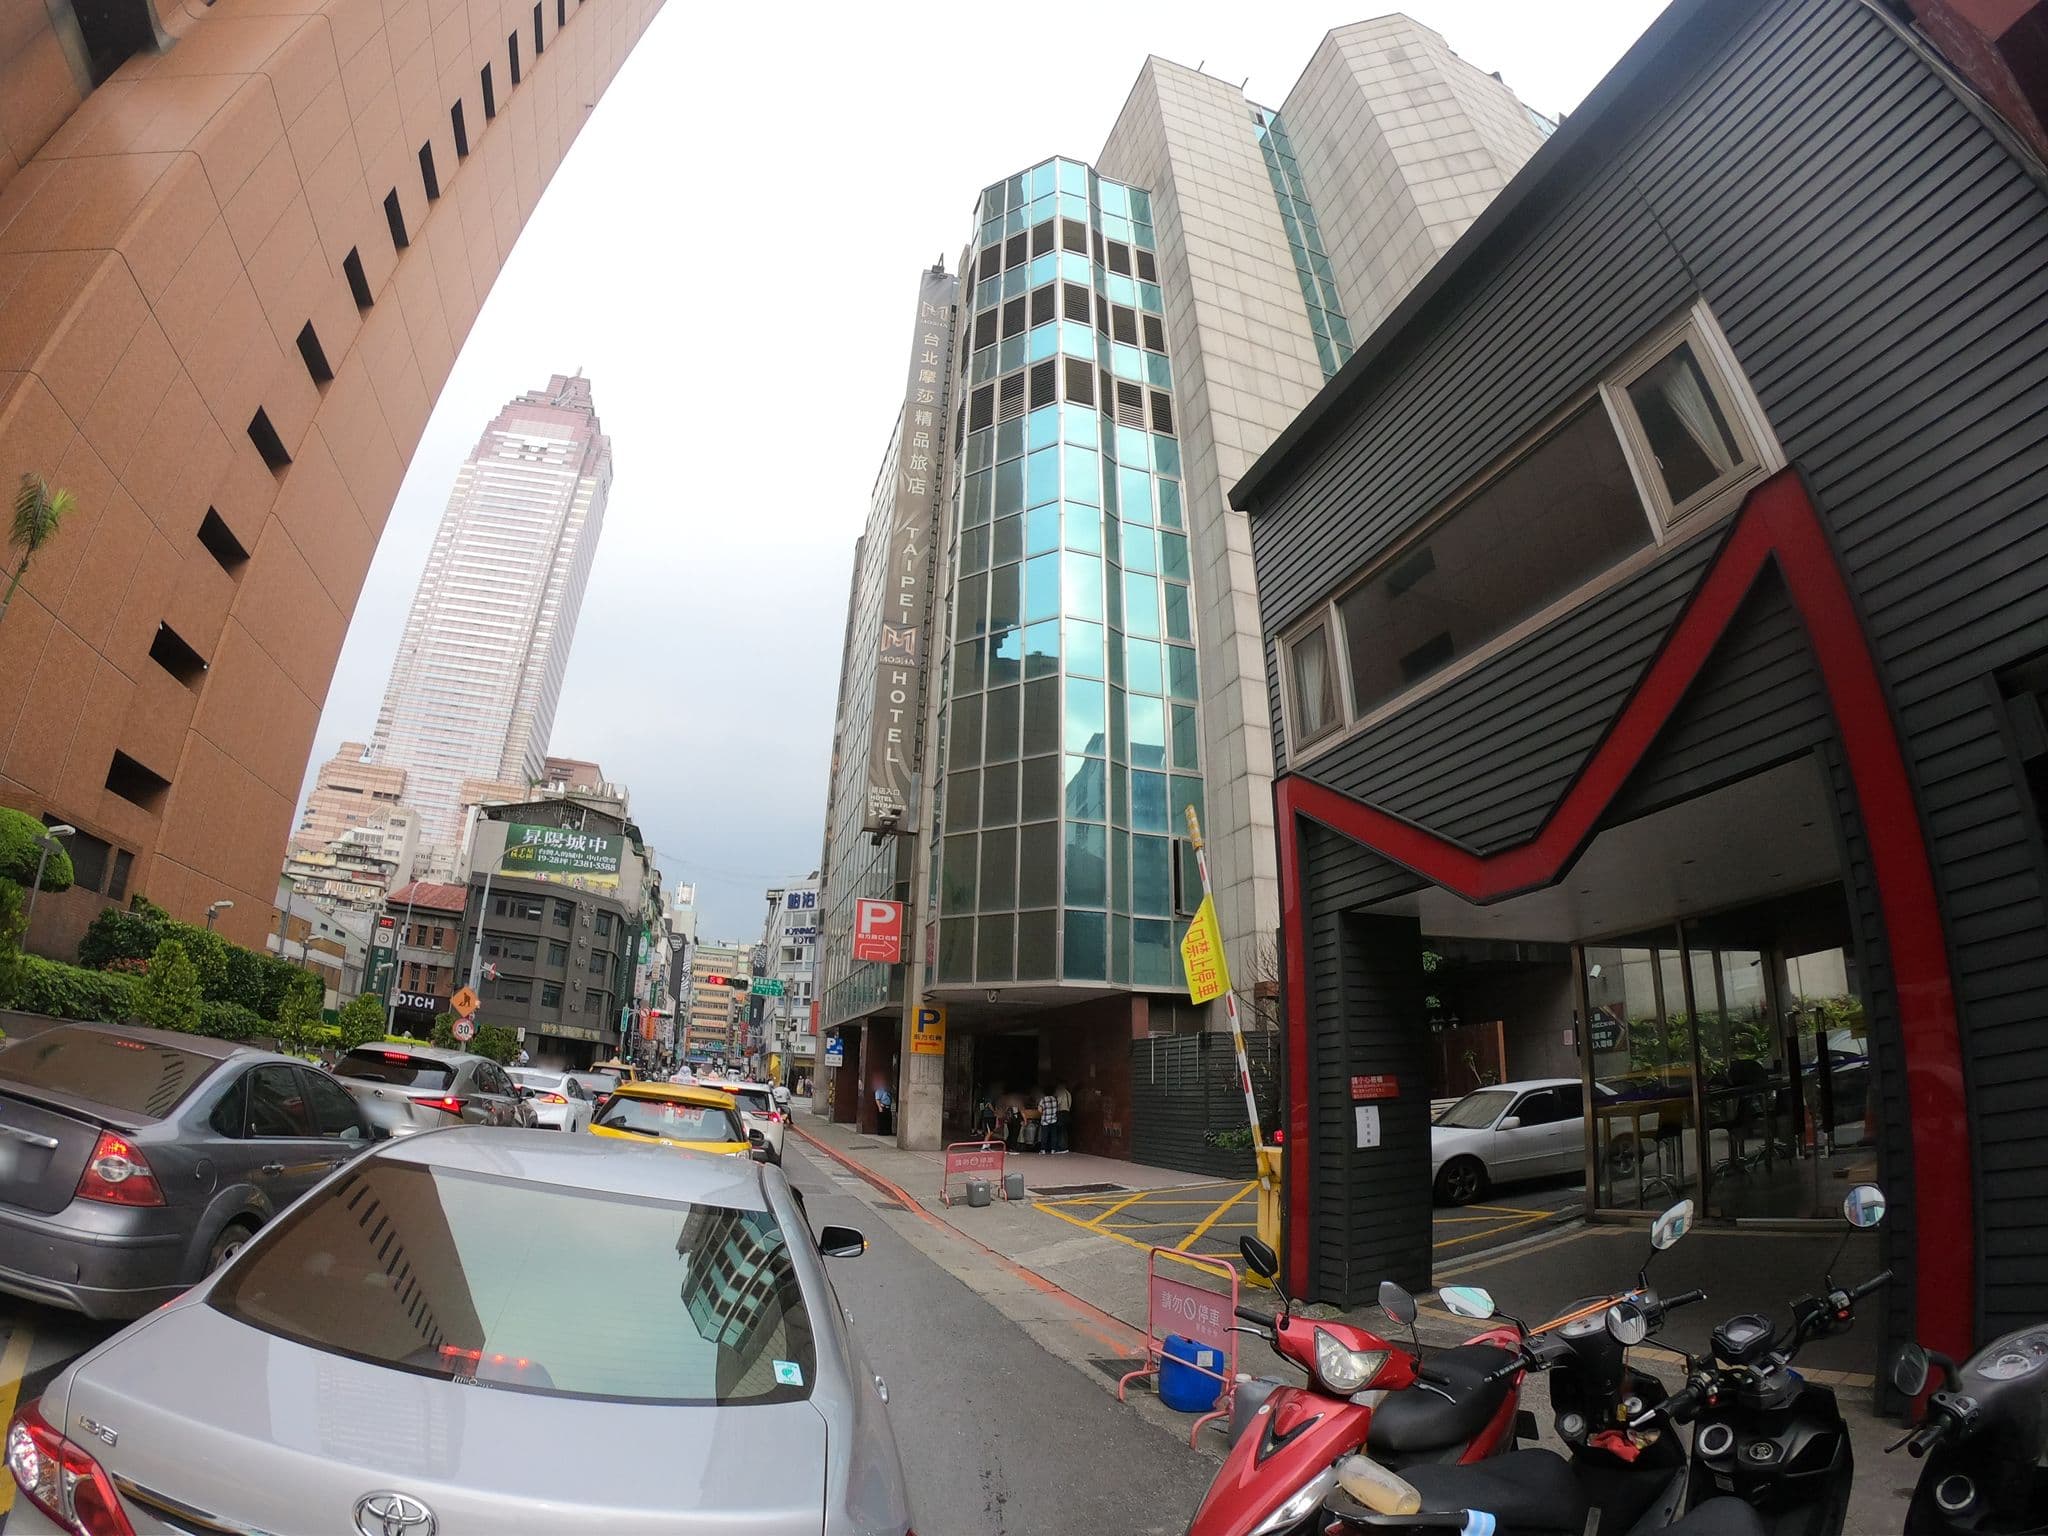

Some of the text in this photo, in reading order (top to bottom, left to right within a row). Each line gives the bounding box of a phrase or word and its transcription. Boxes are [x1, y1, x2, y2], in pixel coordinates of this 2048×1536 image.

[907, 332, 940, 496] 台北摩莎精品旅店
[899, 526, 920, 624] TAIPEI
[886, 670, 908, 763] HOTEL
[523, 829, 607, 853] 昇陽城中
[861, 901, 896, 934] P
[457, 1024, 470, 1035] 30
[918, 1009, 941, 1032] P
[827, 1037, 837, 1050] P
[1160, 1289, 1221, 1328] 請勿 停車
